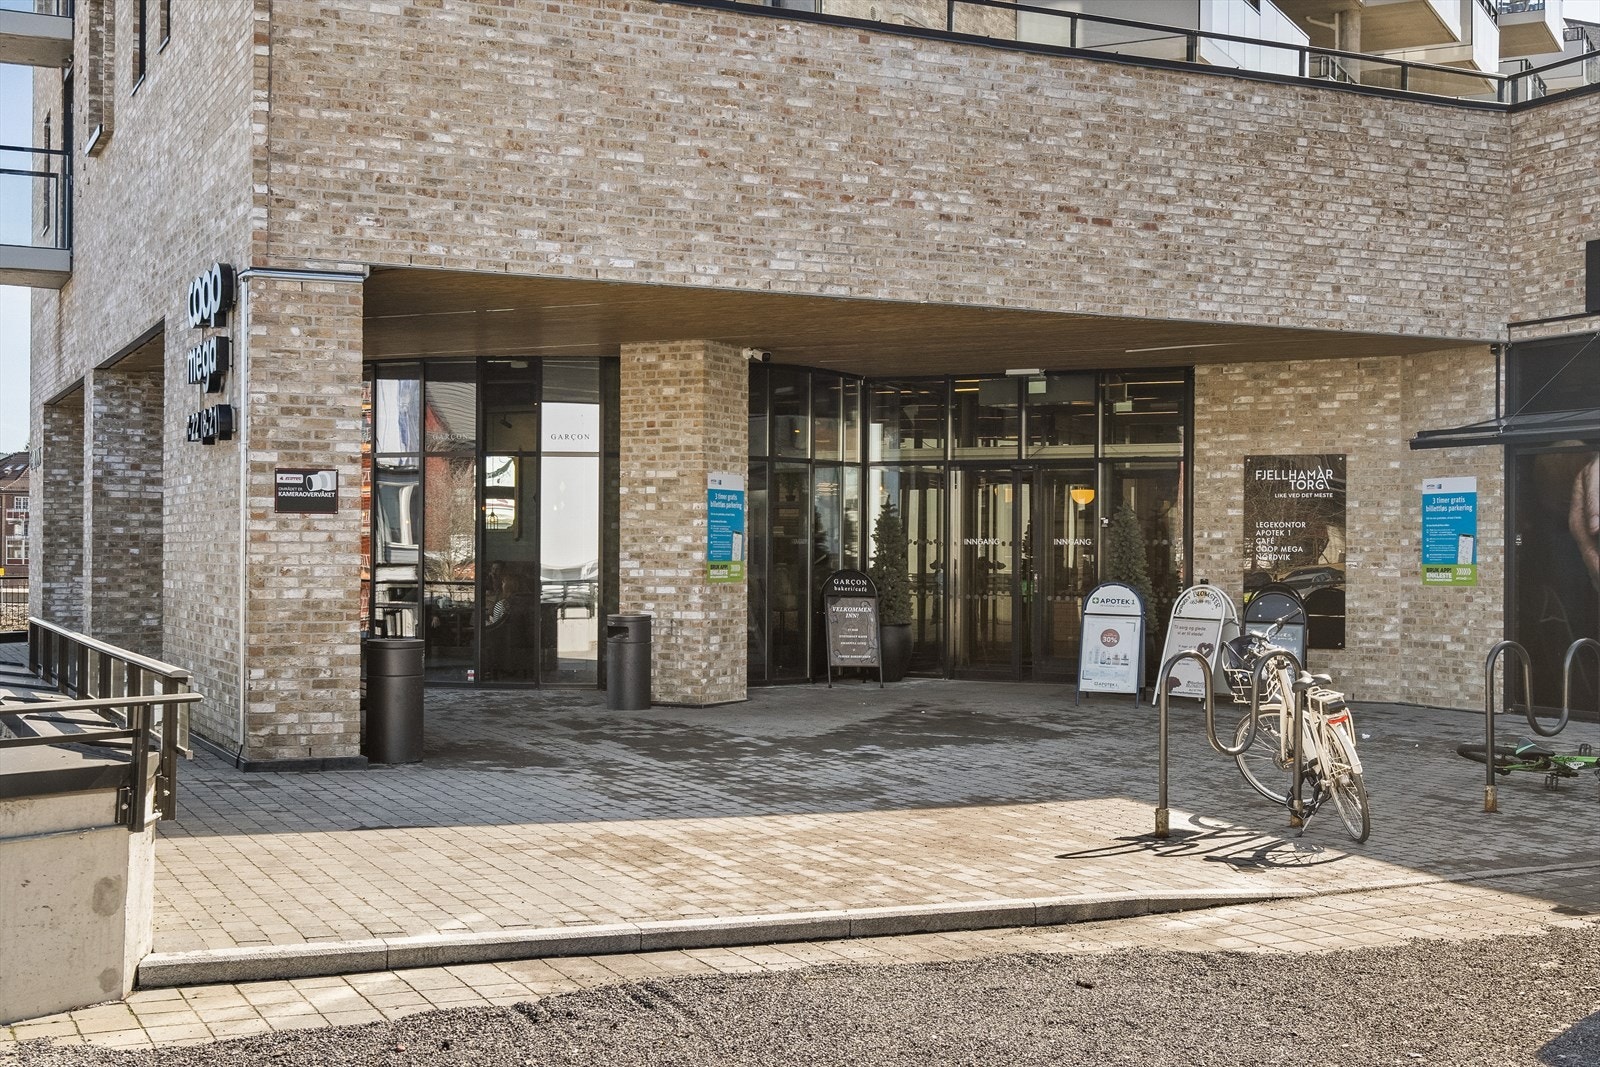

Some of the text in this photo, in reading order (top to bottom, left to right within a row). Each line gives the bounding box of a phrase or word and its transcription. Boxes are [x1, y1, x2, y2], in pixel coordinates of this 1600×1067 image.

[188, 262, 222, 328] coop
[187, 336, 217, 393] mega
[432, 433, 469, 441] GARÇON
[550, 433, 590, 441] GARÇON
[1255, 468, 1333, 480] FJELLHAMAR
[1289, 480, 1324, 490] TORG
[1450, 496, 1466, 504] gratis
[1448, 504, 1472, 512] parkering
